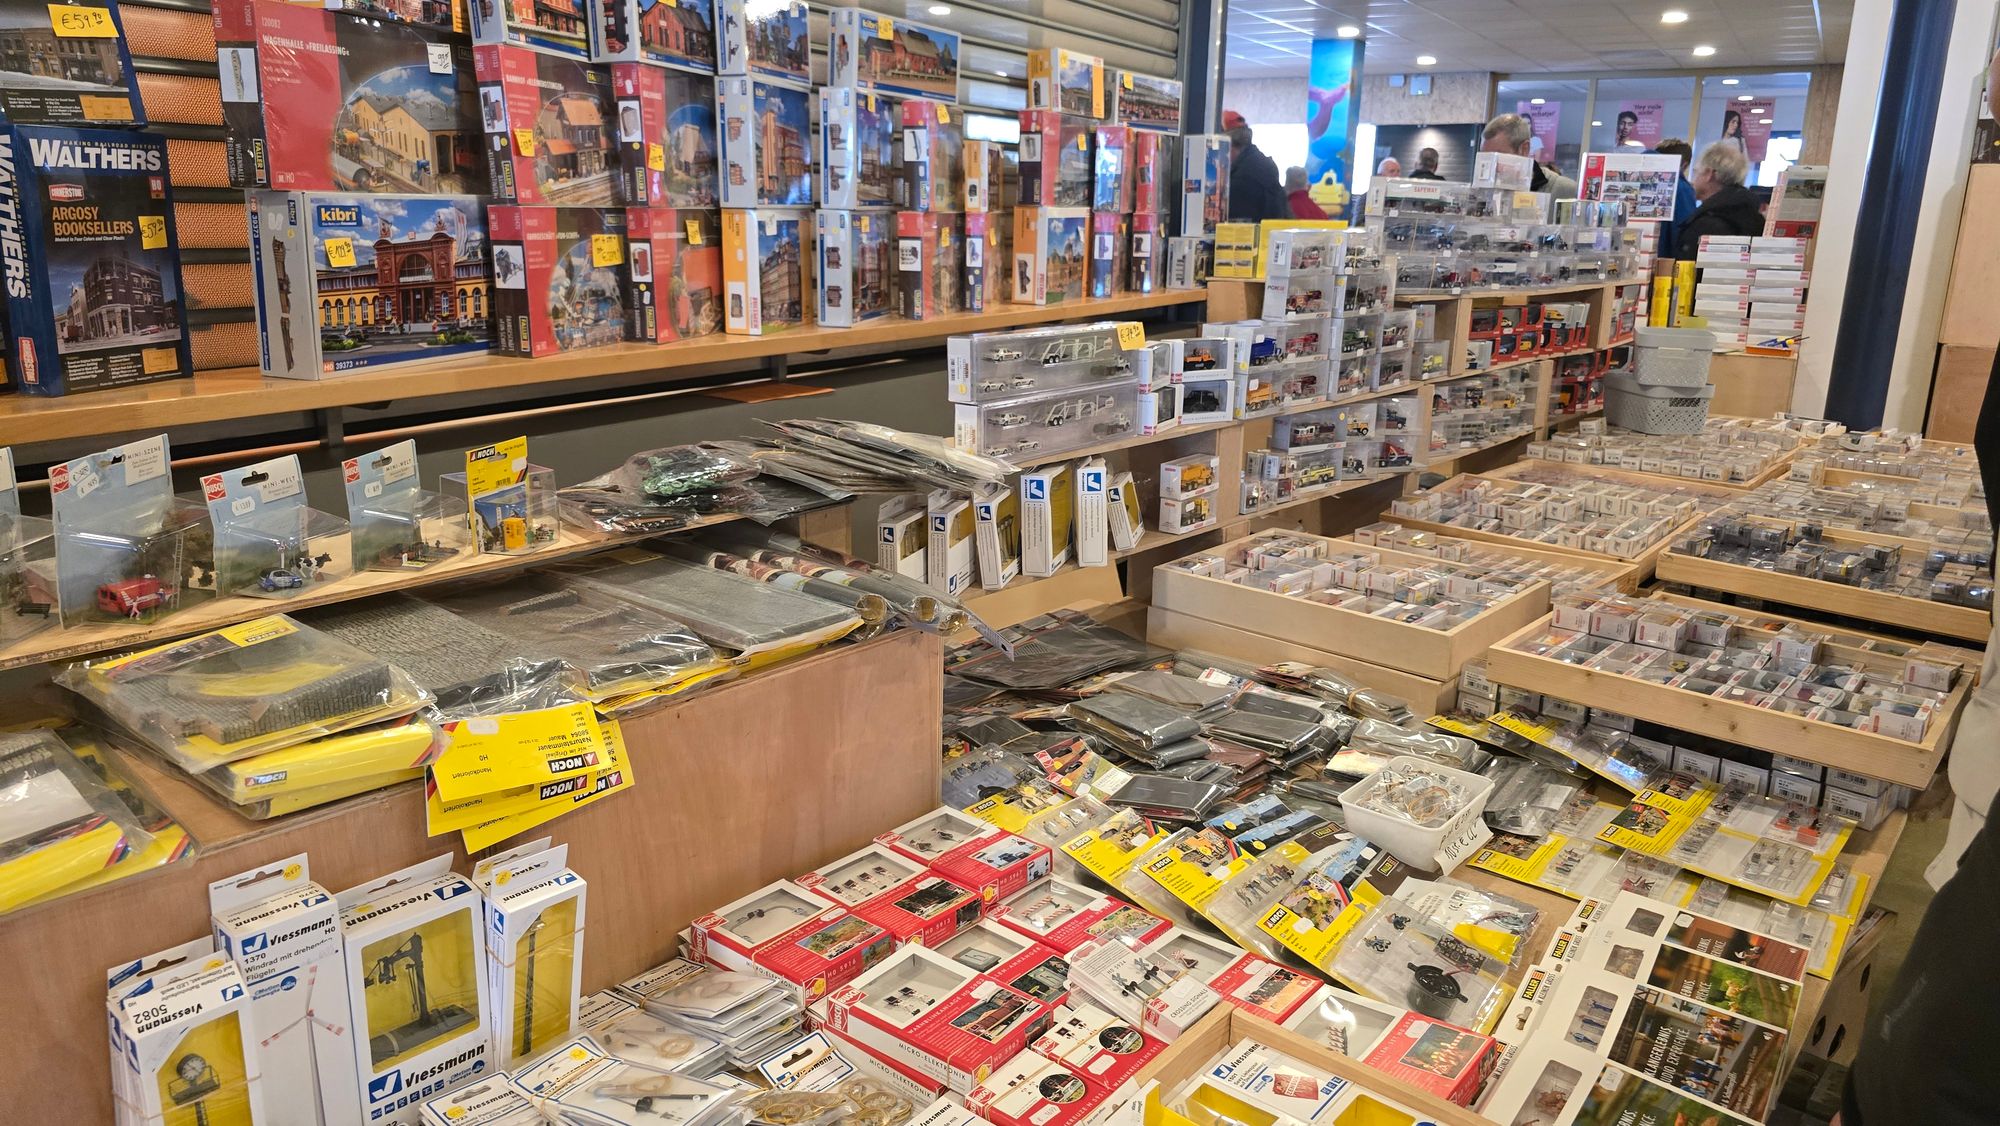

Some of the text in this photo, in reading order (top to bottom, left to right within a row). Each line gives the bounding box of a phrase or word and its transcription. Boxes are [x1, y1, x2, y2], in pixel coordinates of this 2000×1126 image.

[263, 35, 304, 51] WAGENHALLE
[29, 138, 162, 172] WALTHERS
[254, 141, 265, 170] FALLER
[1414, 186, 1439, 194] SAFEWAY
[0, 134, 26, 299] WALTHERS
[52, 207, 99, 222] ARGOSY
[321, 207, 358, 222] kibri
[53, 220, 134, 236] BOOKSELLERS
[520, 318, 528, 341] FALLER
[335, 360, 353, 370] 39373
[127, 446, 162, 460] MINI-SZENE
[477, 449, 495, 459] NOCH
[206, 482, 225, 495] BUSCH
[262, 475, 296, 490] MINI-WELT
[538, 737, 593, 751] Natursteinmauer
[551, 757, 583, 772] NOCH
[258, 772, 286, 784] NOCH
[452, 768, 493, 780] Handkoloriert
[541, 781, 574, 798] NOCH
[443, 798, 483, 813] Handkoloriert
[1156, 857, 1173, 870] NOCH
[504, 880, 555, 902] Viessmann
[236, 901, 301, 929] Viessmann
[347, 892, 433, 928] Viessmann
[1271, 908, 1286, 923] NOCH
[270, 917, 334, 946] Viessmann
[1552, 936, 1567, 960] FALLER
[245, 953, 267, 965] 1370
[245, 952, 293, 974] Windrad mit
[246, 967, 276, 982] Flügeln
[1523, 976, 1540, 1001] FALLER
[1539, 985, 1550, 1000] KLEINEN
[1170, 988, 1209, 1019] CROSSING SIGNALS
[133, 1003, 168, 1024] 5082
[138, 1003, 203, 1034] Viessmann
[832, 1004, 842, 1030] BUSCH
[1671, 1027, 1692, 1063] EXPERIENCE.
[1230, 1043, 1261, 1069] Viessmann
[1496, 1056, 1510, 1072] KLEINEN
[1507, 1044, 1519, 1059] GROSS
[406, 1044, 486, 1089] Viessmann
[466, 1090, 516, 1115] Viessmann
